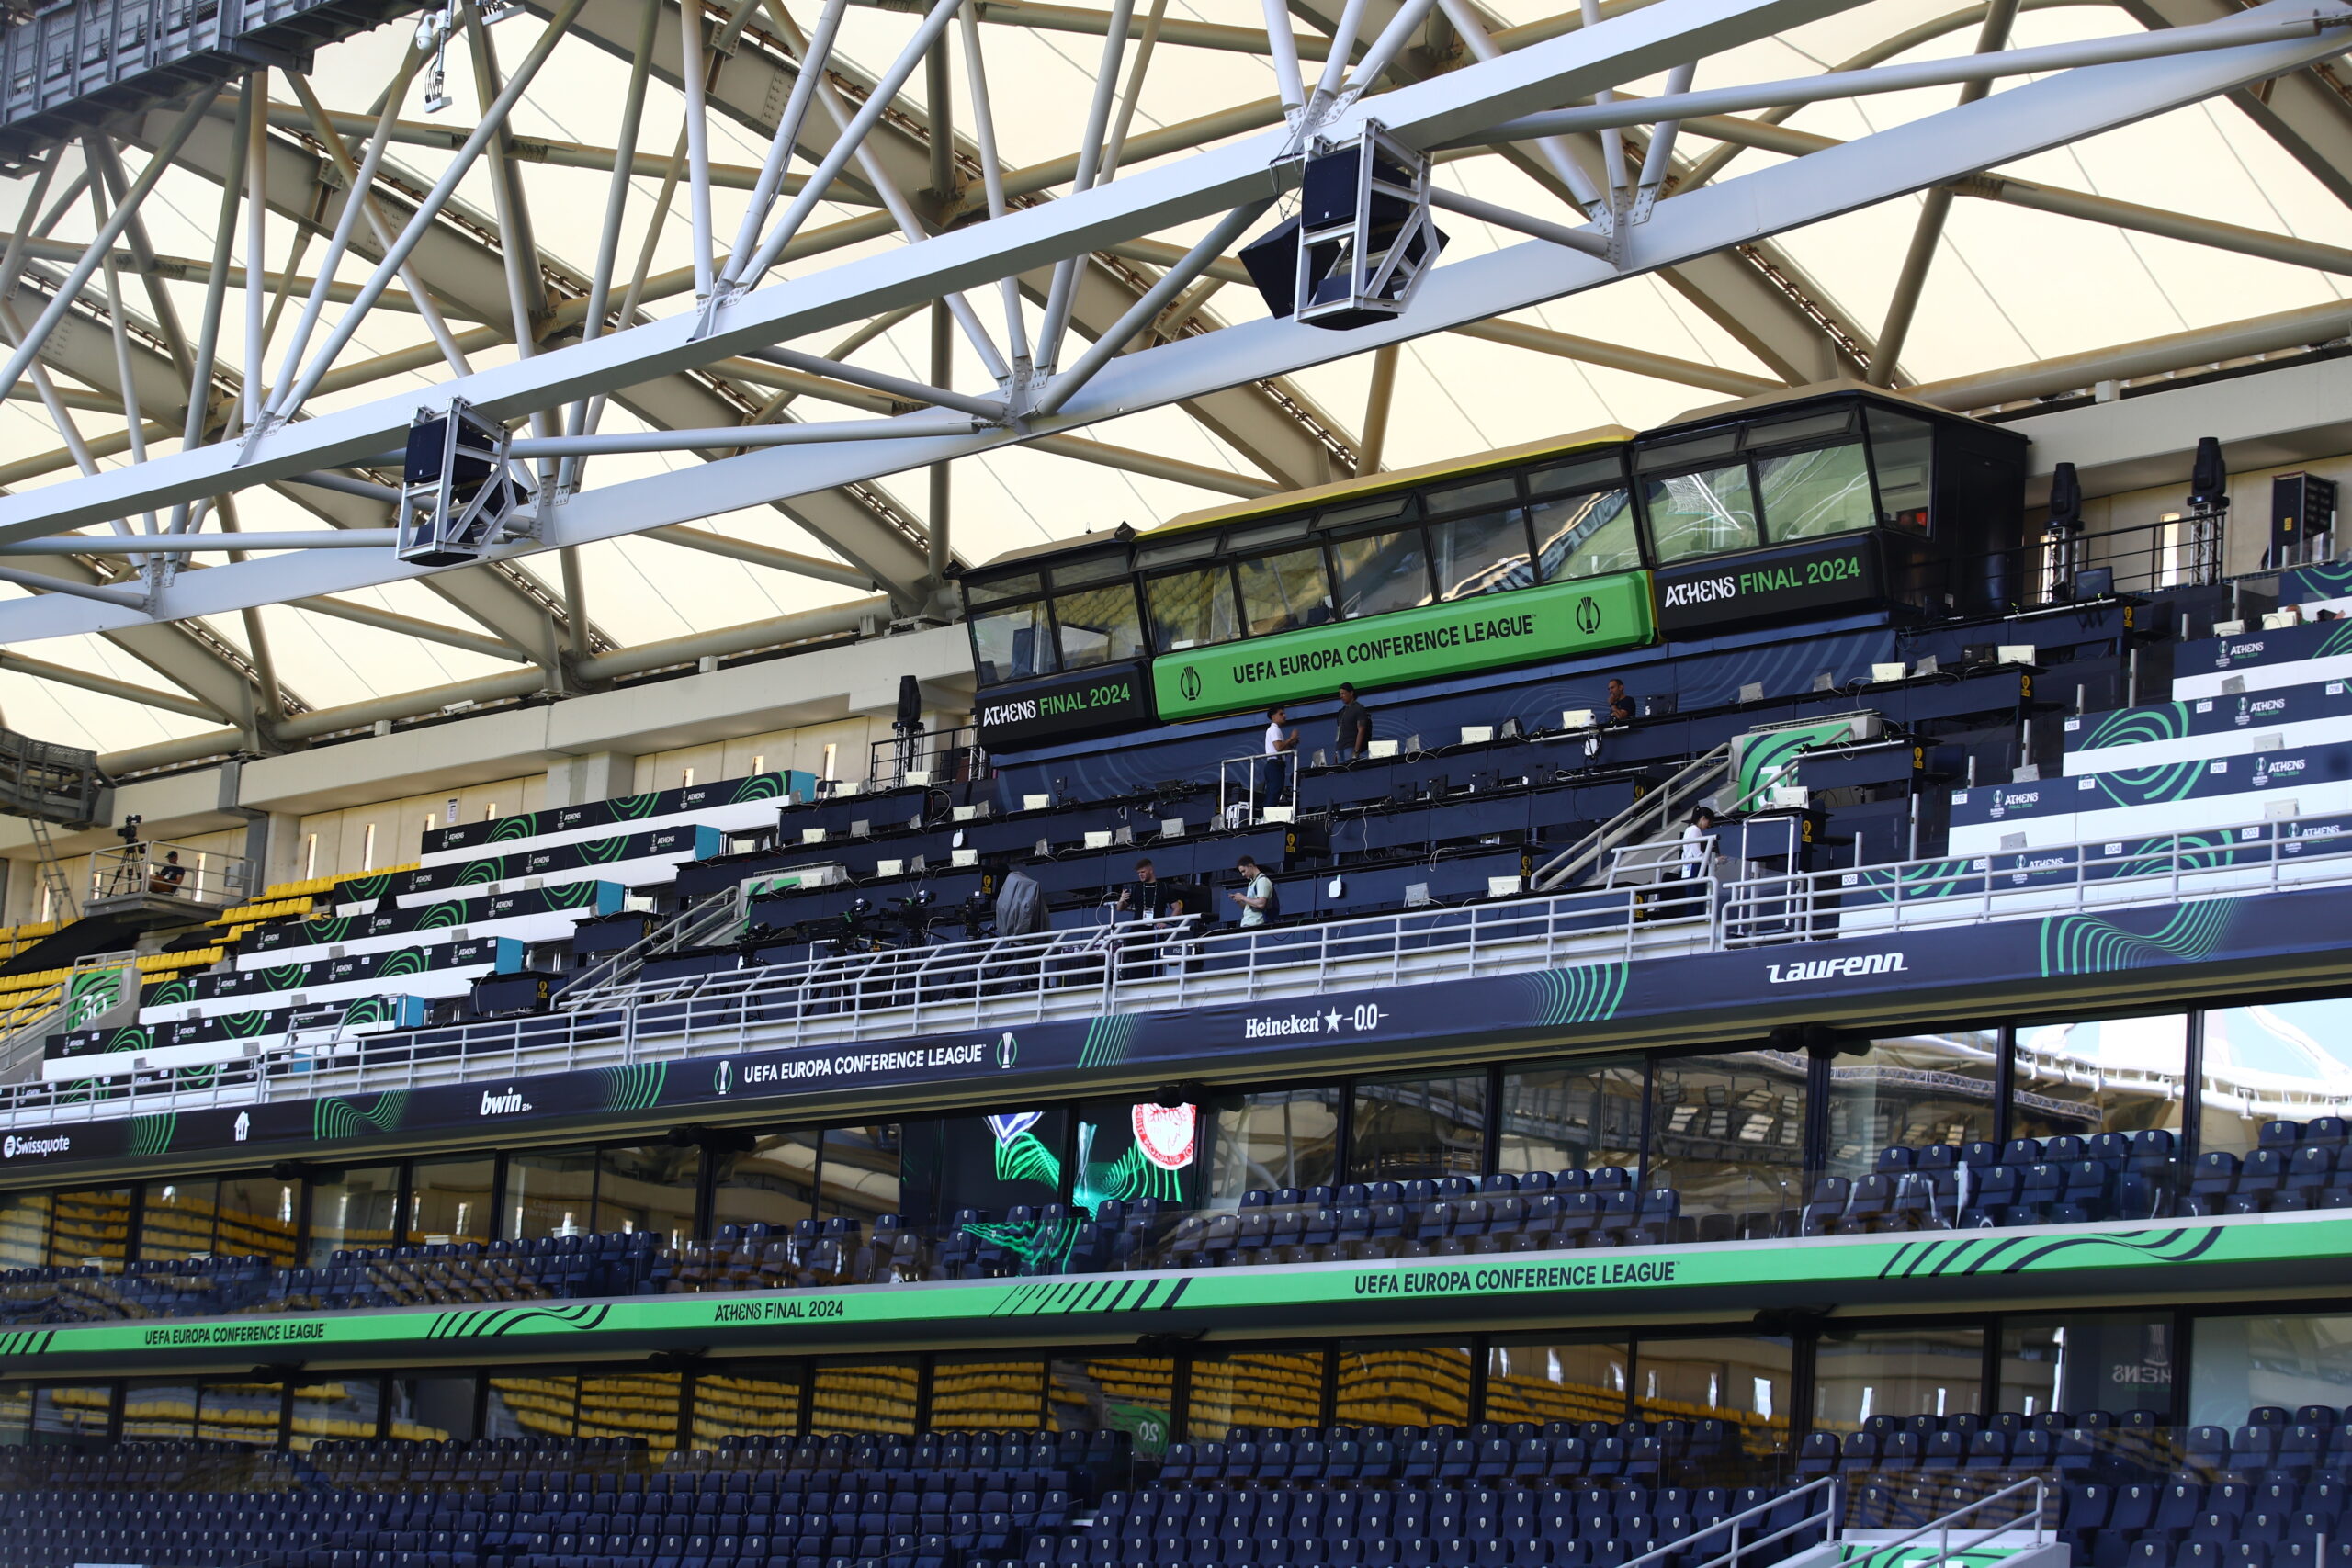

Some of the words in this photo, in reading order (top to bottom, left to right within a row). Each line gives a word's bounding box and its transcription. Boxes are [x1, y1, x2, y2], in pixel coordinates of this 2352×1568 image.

[1664, 575, 1736, 610] ATHENS
[1740, 565, 1803, 596] FINAL
[1806, 556, 1860, 585] 2024
[1233, 658, 1276, 684] UEFA
[1280, 647, 1344, 676] EUROPA
[1347, 627, 1462, 664] CONFERENCE
[1464, 614, 1534, 645] LEAGUE
[2230, 641, 2264, 656] ATHENS
[982, 698, 1036, 727] ATHENS
[1039, 690, 1086, 716] FINAL
[1091, 682, 1131, 707] 2024
[2250, 698, 2286, 713] ATHENS
[2268, 759, 2305, 773] ATHENS
[2005, 792, 2039, 806] ATHENS
[2302, 824, 2340, 837] ATHENS
[2029, 857, 2064, 868] ATHENS
[1766, 953, 1908, 984] Laufenn
[1245, 1013, 1319, 1039] Heineken
[744, 1065, 778, 1083] UEFA
[781, 1058, 832, 1080] EUROPA
[834, 1050, 927, 1074] CONFERENCE
[928, 1043, 982, 1065] LEAGUE
[480, 1088, 522, 1116] bwin
[16, 1134, 70, 1157] Swissquote
[1355, 1274, 1399, 1294] UEFA
[1404, 1270, 1471, 1292] EUROPA
[1476, 1265, 1596, 1290] CONFERENCE
[1602, 1260, 1675, 1285] LEAGUE
[714, 1302, 762, 1323] ATHENS
[765, 1301, 805, 1319] FINAL
[808, 1300, 843, 1317] 2024
[145, 1328, 172, 1346] UEFA
[173, 1326, 210, 1344] EUROPA
[213, 1324, 280, 1343] CONFERENCE
[283, 1323, 324, 1341] LEAGUE
